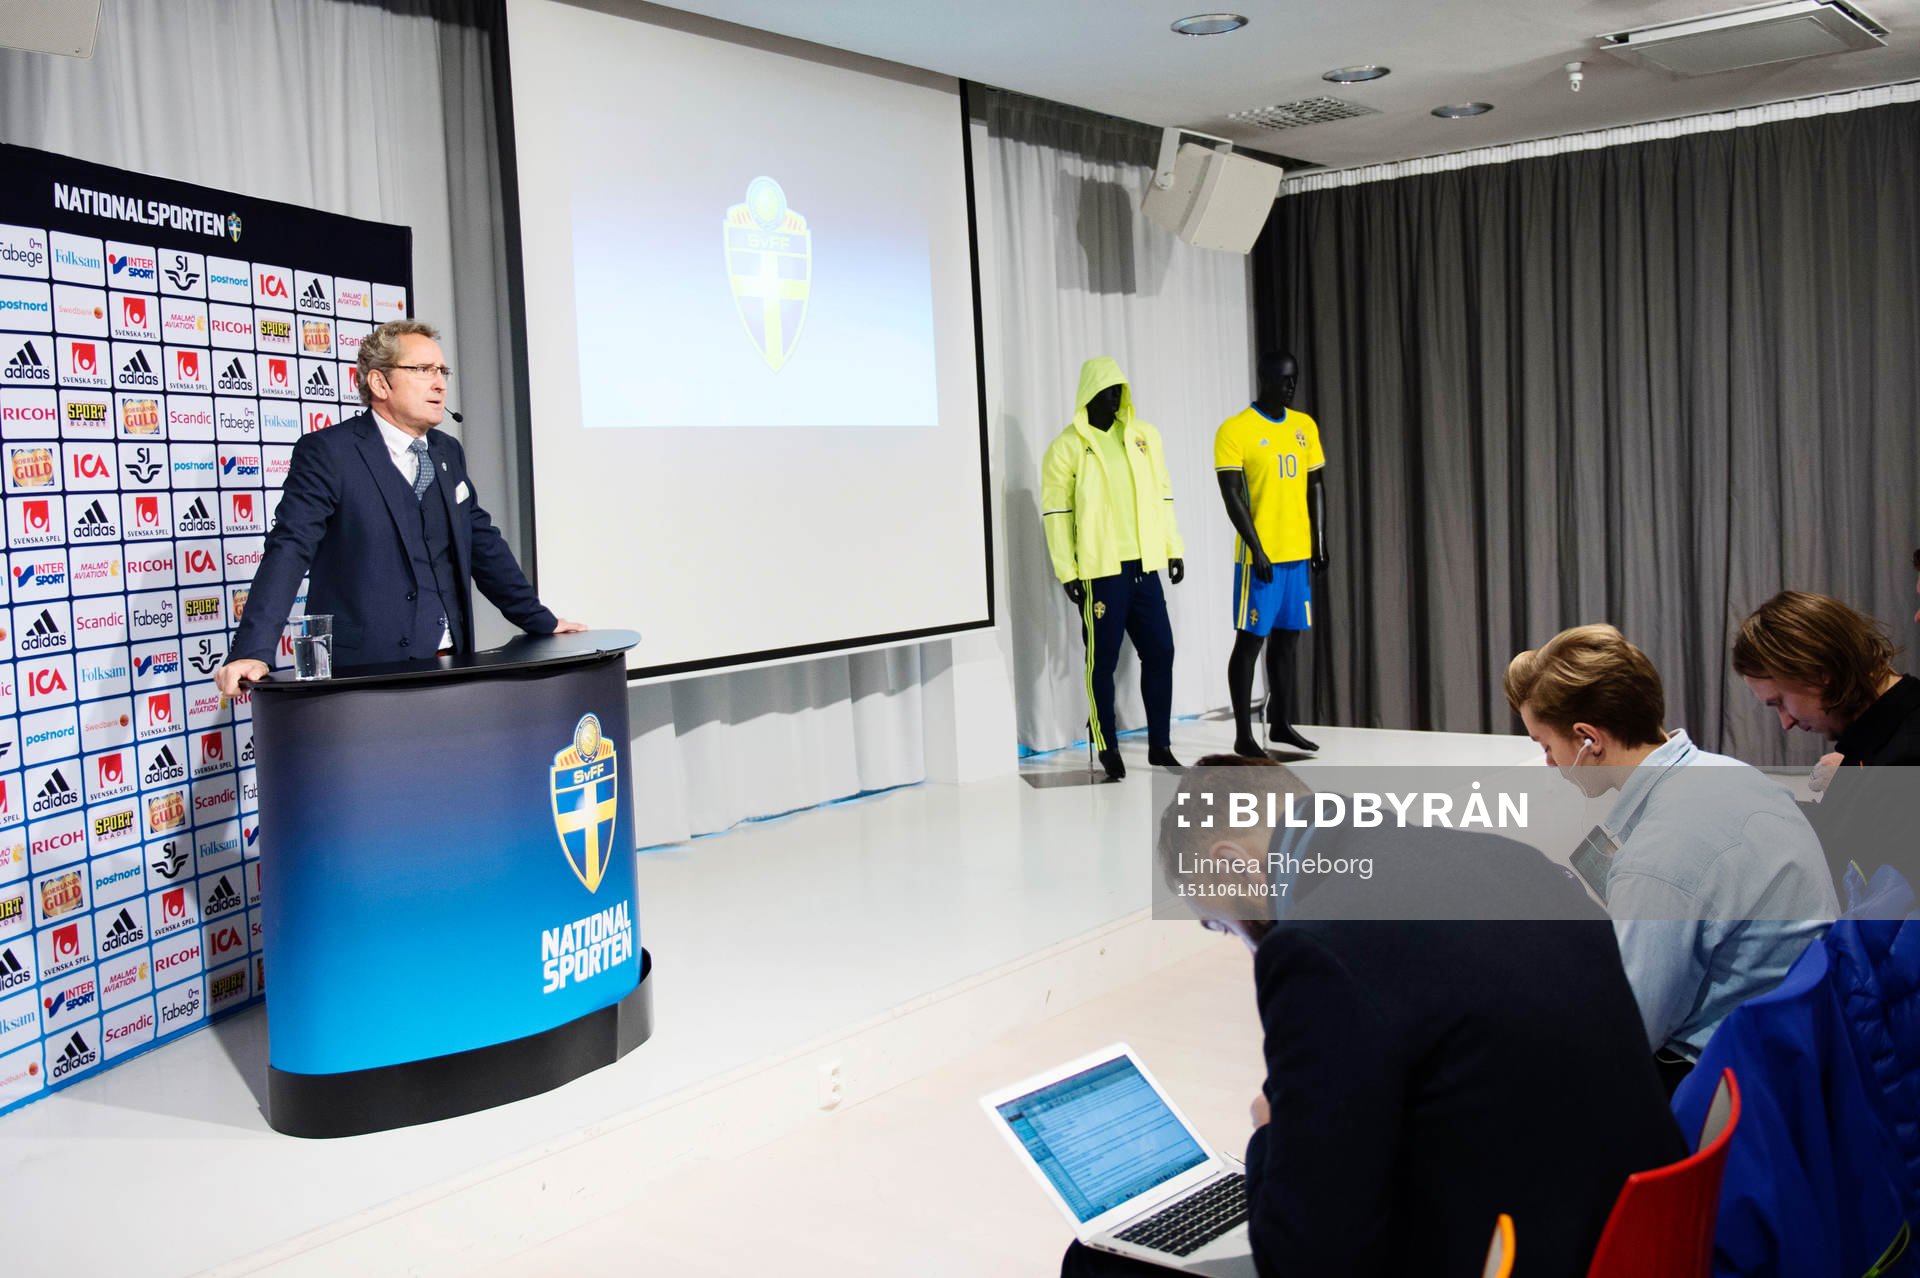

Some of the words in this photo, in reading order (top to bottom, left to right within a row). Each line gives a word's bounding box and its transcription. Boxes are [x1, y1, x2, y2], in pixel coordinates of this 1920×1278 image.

[54, 182, 225, 238] NATIONALSPORTEN
[55, 249, 100, 269] Folksam
[128, 256, 154, 269] INTER
[176, 255, 188, 273] SJ
[128, 268, 154, 280] SPORT
[210, 274, 248, 287] postnord
[260, 274, 289, 299] ICA
[300, 298, 331, 311] adidas
[115, 329, 141, 338] SVENSKA
[143, 331, 157, 339] SPEL
[164, 320, 194, 330] AVIATION
[211, 320, 252, 335] RICOH
[261, 320, 290, 338] SPORT
[304, 333, 330, 346] GULD
[4, 366, 50, 380] adidas
[63, 376, 91, 385] SVENSKA
[93, 378, 108, 386] SPEL
[119, 371, 158, 386] adidas
[195, 383, 209, 391] SPEL
[218, 378, 253, 391] adidas
[304, 385, 335, 397] adidas
[3, 407, 56, 420] RICOH
[67, 402, 107, 421] SPORT
[125, 412, 158, 427] GULD
[170, 411, 212, 425] Scandic
[220, 412, 255, 433] Fabege
[264, 414, 298, 429] Folksam
[309, 412, 333, 432] ICA
[137, 447, 150, 464] SJ
[236, 456, 259, 466] INTER
[14, 462, 53, 480] GULD
[73, 453, 110, 478] ICA
[174, 461, 214, 472] postnord
[237, 465, 259, 475] SPORT
[1277, 454, 1297, 478] 10
[73, 523, 116, 538] adidas
[127, 530, 154, 538] SVENSKA
[179, 518, 216, 532] adidas
[13, 536, 45, 545] SVENSKA
[46, 535, 61, 543] SPEL
[35, 562, 65, 575] INTER
[127, 559, 173, 573] RICOH
[184, 550, 217, 573] ICA
[35, 573, 65, 586] SPORT
[74, 569, 108, 580] AVIATION
[185, 598, 219, 616] SPORT
[76, 612, 124, 630] Scandic
[133, 609, 174, 628] Fabege
[21, 633, 67, 651] adidas
[198, 639, 212, 656] SJ
[152, 652, 178, 665] INTER
[81, 666, 126, 683] Folksam
[153, 662, 179, 675] SPORT
[28, 668, 68, 697] ICA
[188, 704, 219, 716] AVIATION
[26, 725, 75, 747] postnord
[140, 728, 167, 738] SVENSKA
[168, 724, 182, 733] SPEL
[144, 766, 184, 784] adidas
[194, 764, 218, 776] SVENSKA
[219, 761, 232, 770] SPEL
[573, 762, 604, 785] SvFF
[32, 791, 78, 813] adidas
[90, 789, 118, 801] SVENSKA
[119, 785, 134, 794] SPEL
[195, 788, 236, 810] Scandic
[95, 810, 133, 836] SPORT
[151, 804, 184, 827] GULD
[32, 830, 84, 855] RICOH
[98, 828, 134, 842] BLADET
[163, 841, 176, 859] SJ
[200, 838, 238, 858] Folksam
[95, 865, 141, 890] postnord
[44, 885, 82, 911] GULD
[204, 895, 241, 916] adidas
[154, 922, 181, 937] SVENSKA
[181, 917, 196, 927] SPEL
[541, 899, 631, 962] NATIONAL
[102, 928, 144, 952] adidas
[210, 925, 242, 956] ICA
[44, 963, 74, 977] SVENSKA
[75, 955, 91, 967] SPEL
[155, 946, 200, 972] RICOH
[542, 927, 632, 994] SPORTEN
[0, 970, 31, 991] idas
[103, 976, 137, 995] AVIATION
[211, 968, 246, 998] SPORT
[65, 981, 94, 1000] INTER
[66, 990, 95, 1011] SPORT
[162, 998, 200, 1023] Fabege
[105, 1015, 153, 1043] Scandic
[53, 1050, 96, 1078] adidas
